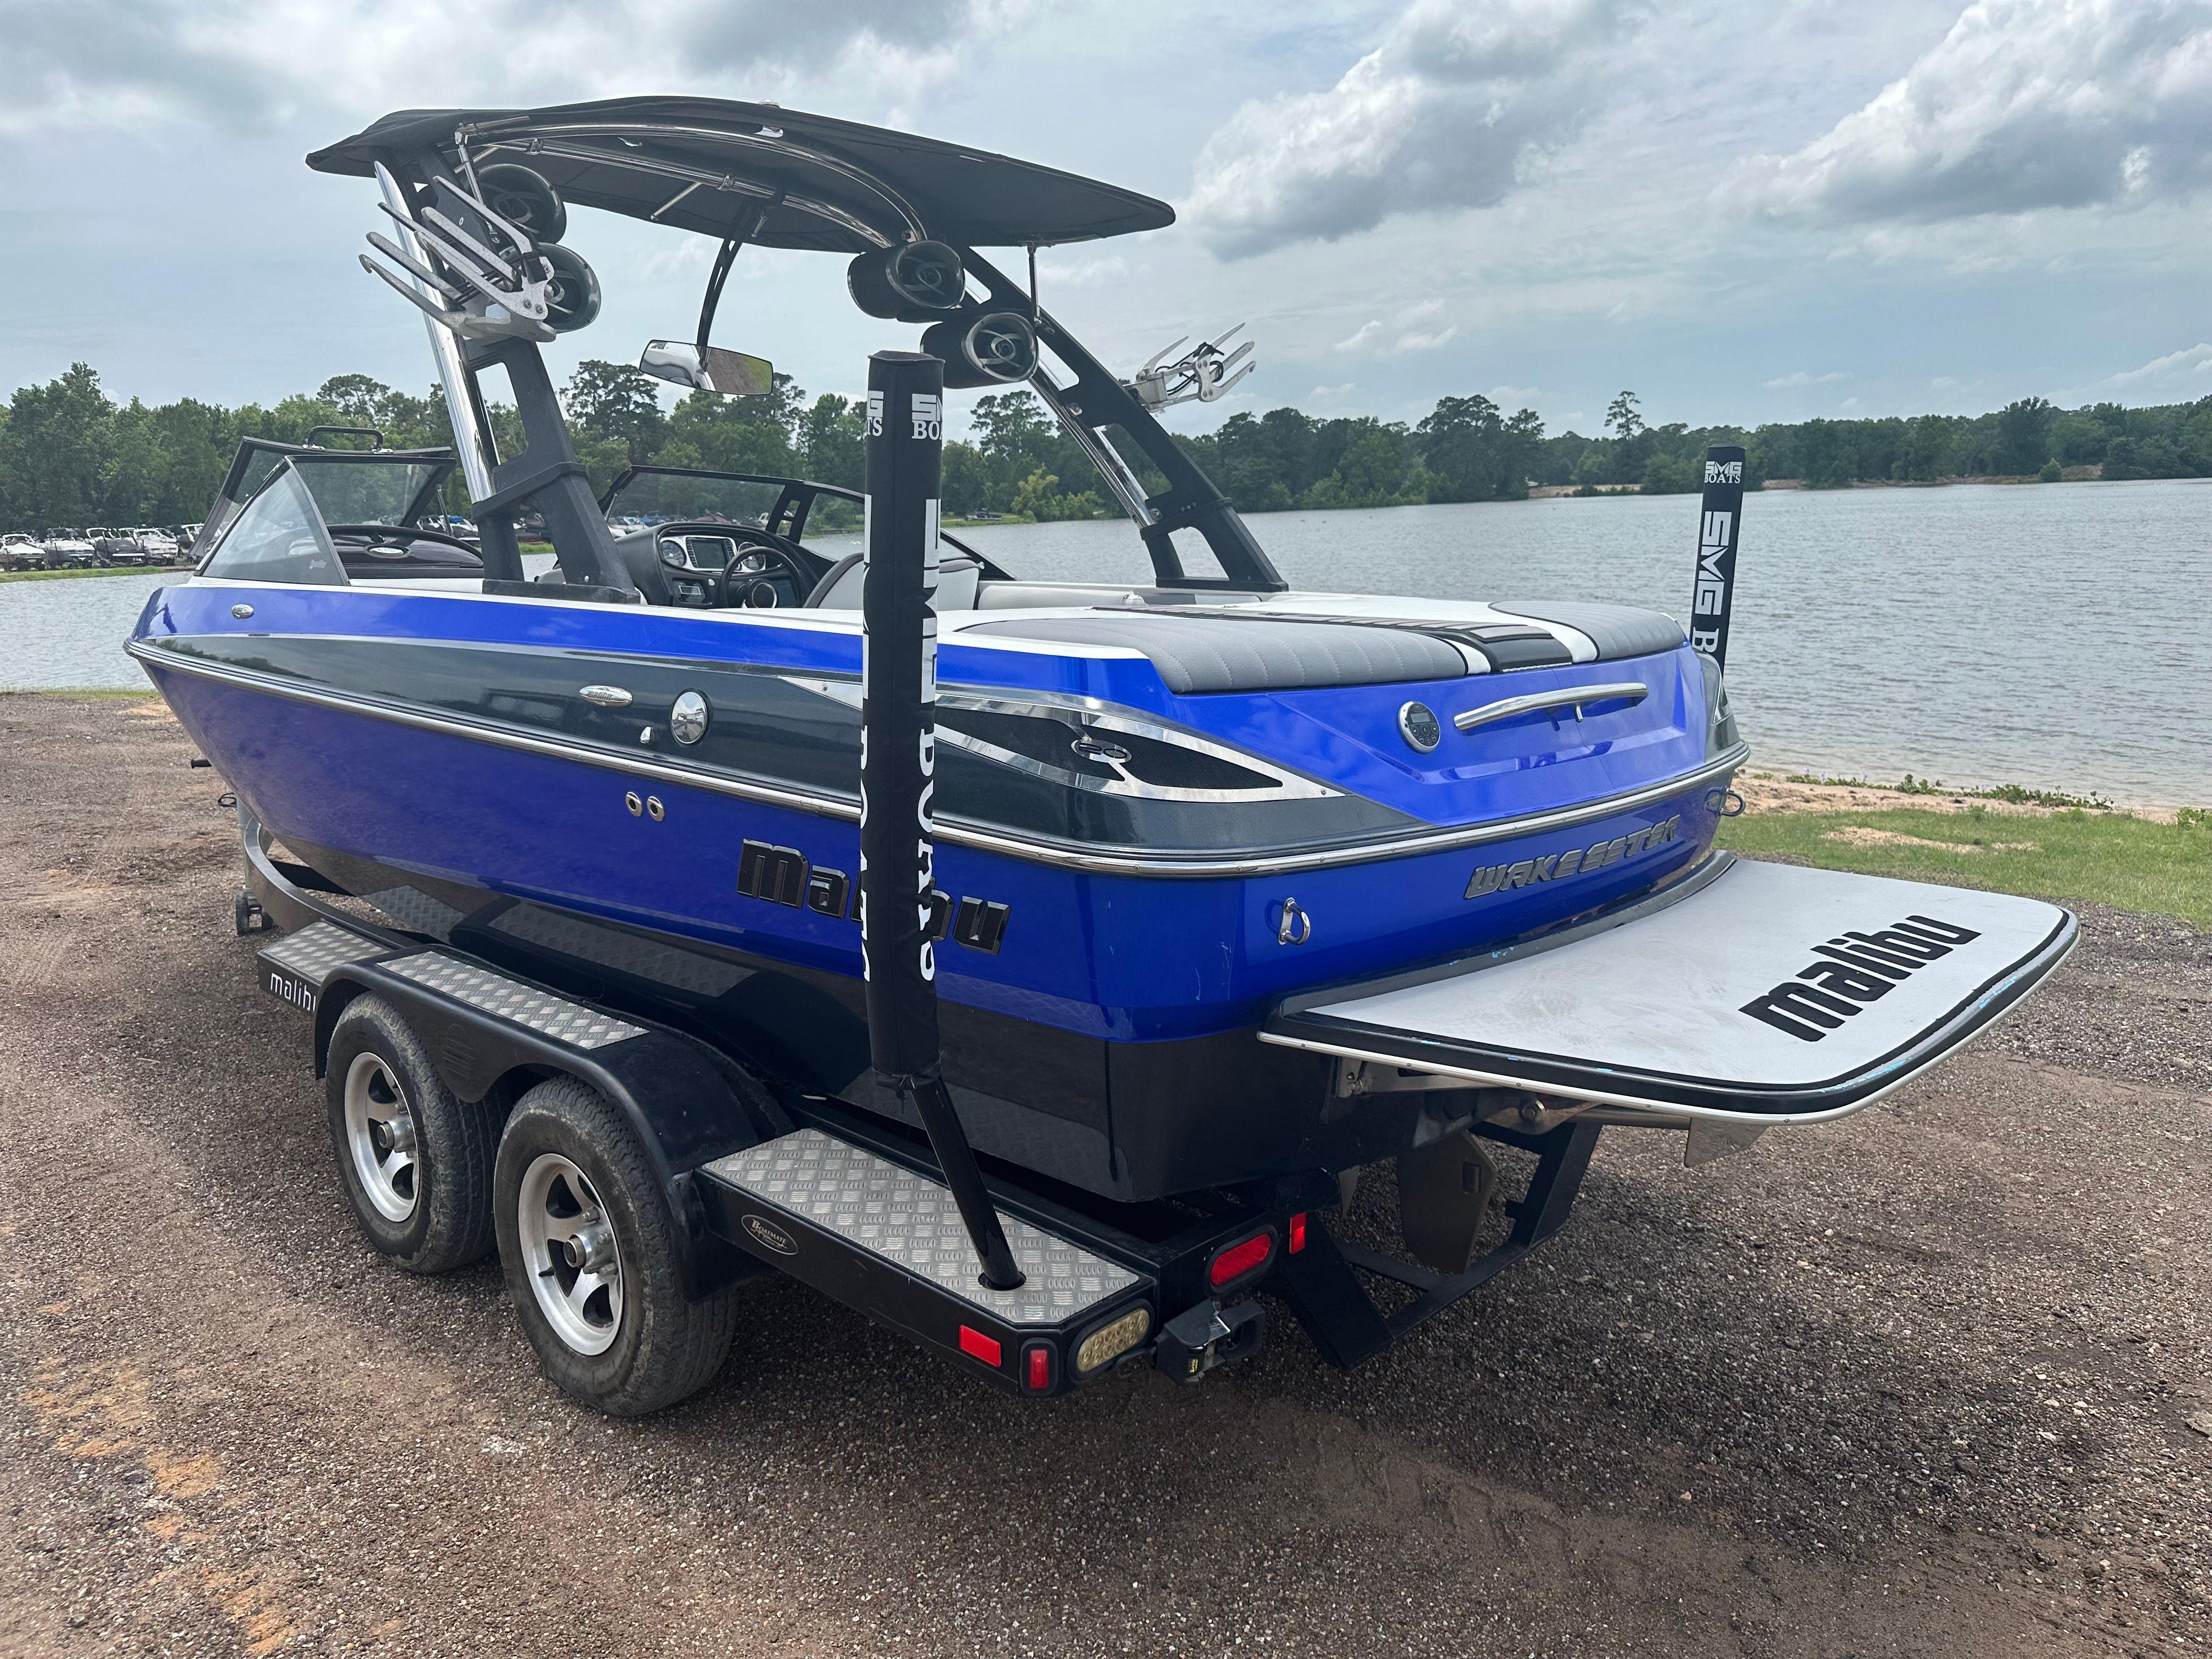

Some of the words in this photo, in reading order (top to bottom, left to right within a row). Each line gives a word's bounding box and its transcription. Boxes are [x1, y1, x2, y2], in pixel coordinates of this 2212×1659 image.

[1705, 461, 1742, 475] SMG
[1705, 473, 1741, 484] BOATS
[1695, 511, 1733, 616] SMG
[1464, 814, 1680, 900] WAKESETTER
[1738, 915, 1982, 1042] malibu
